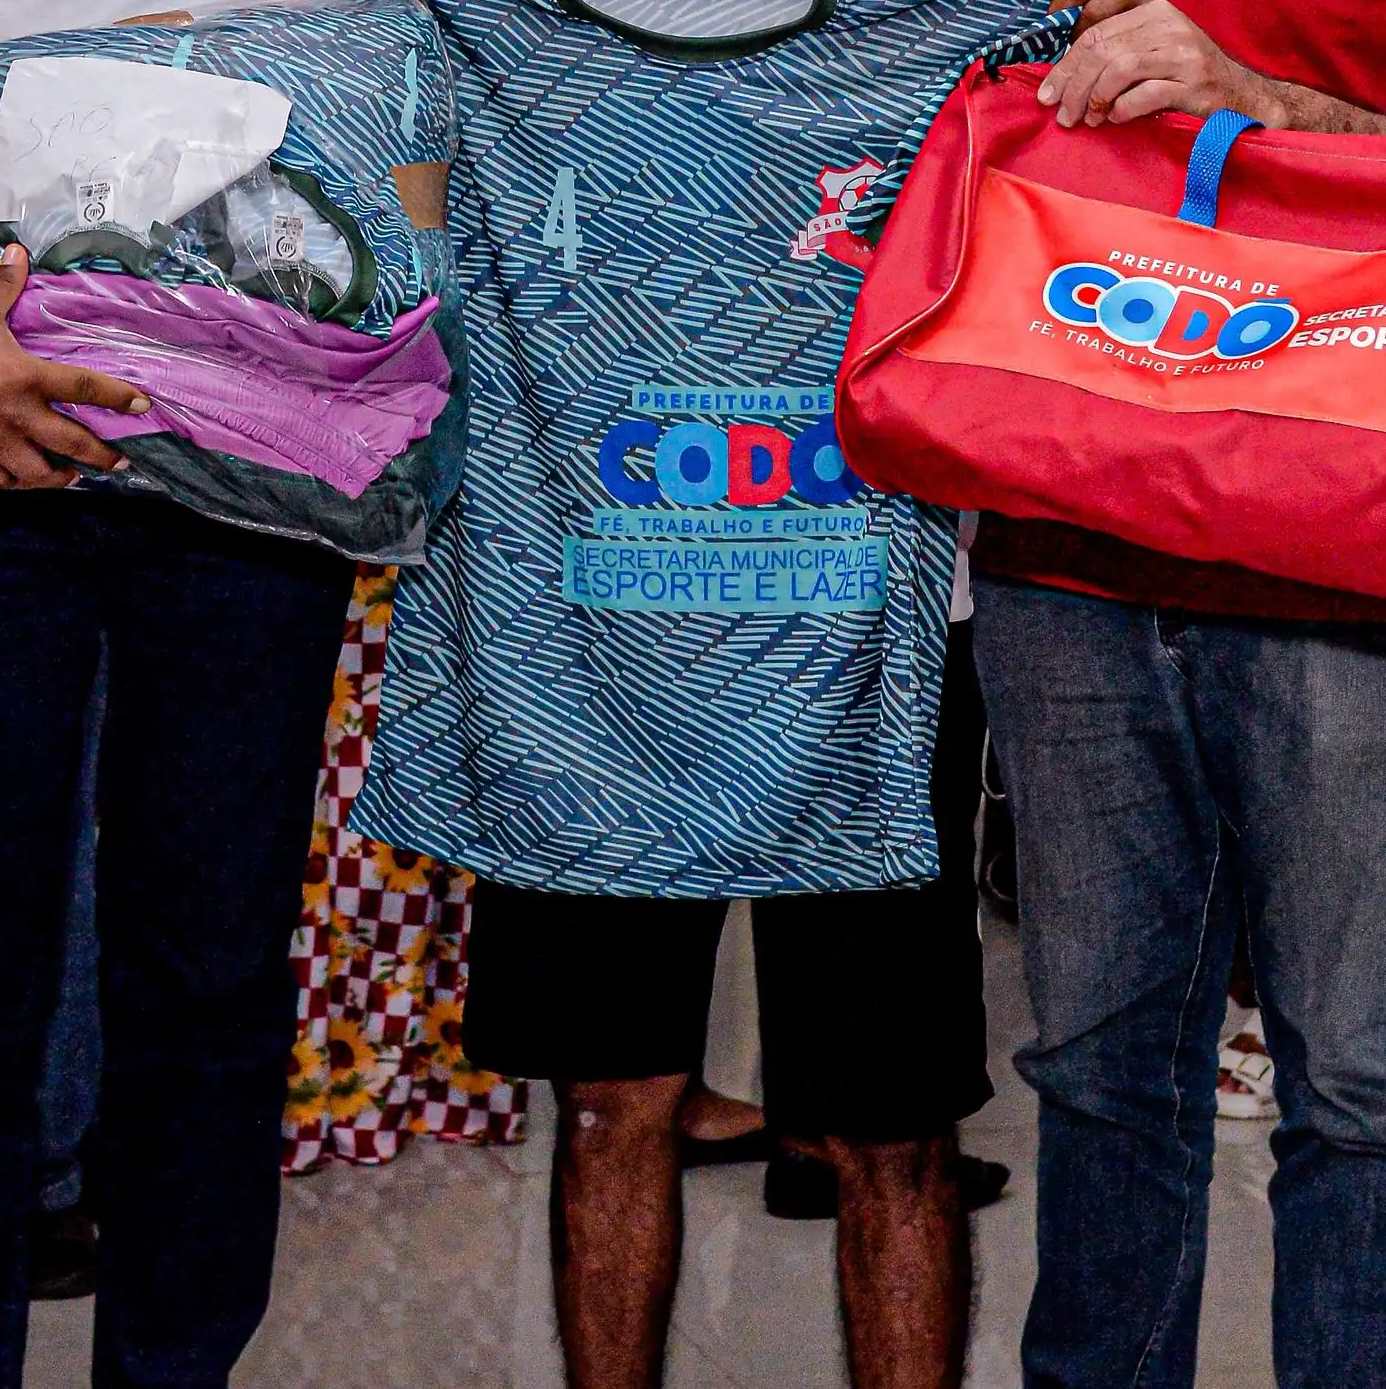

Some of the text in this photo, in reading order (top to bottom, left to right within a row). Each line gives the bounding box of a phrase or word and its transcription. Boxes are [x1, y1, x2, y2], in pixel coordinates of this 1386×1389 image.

[1108, 250, 1280, 297] PREFEITURA DE
[1028, 319, 1265, 377] FÉ, TRABALHO E FUTURO
[638, 391, 830, 411] PREFEITURA DE
[599, 513, 865, 534] FÉ, TRABALHO E FUTURO
[572, 544, 879, 572] SECRETARIA MUNICIPAL DE
[573, 565, 883, 603] ESPORTE E LAZER
